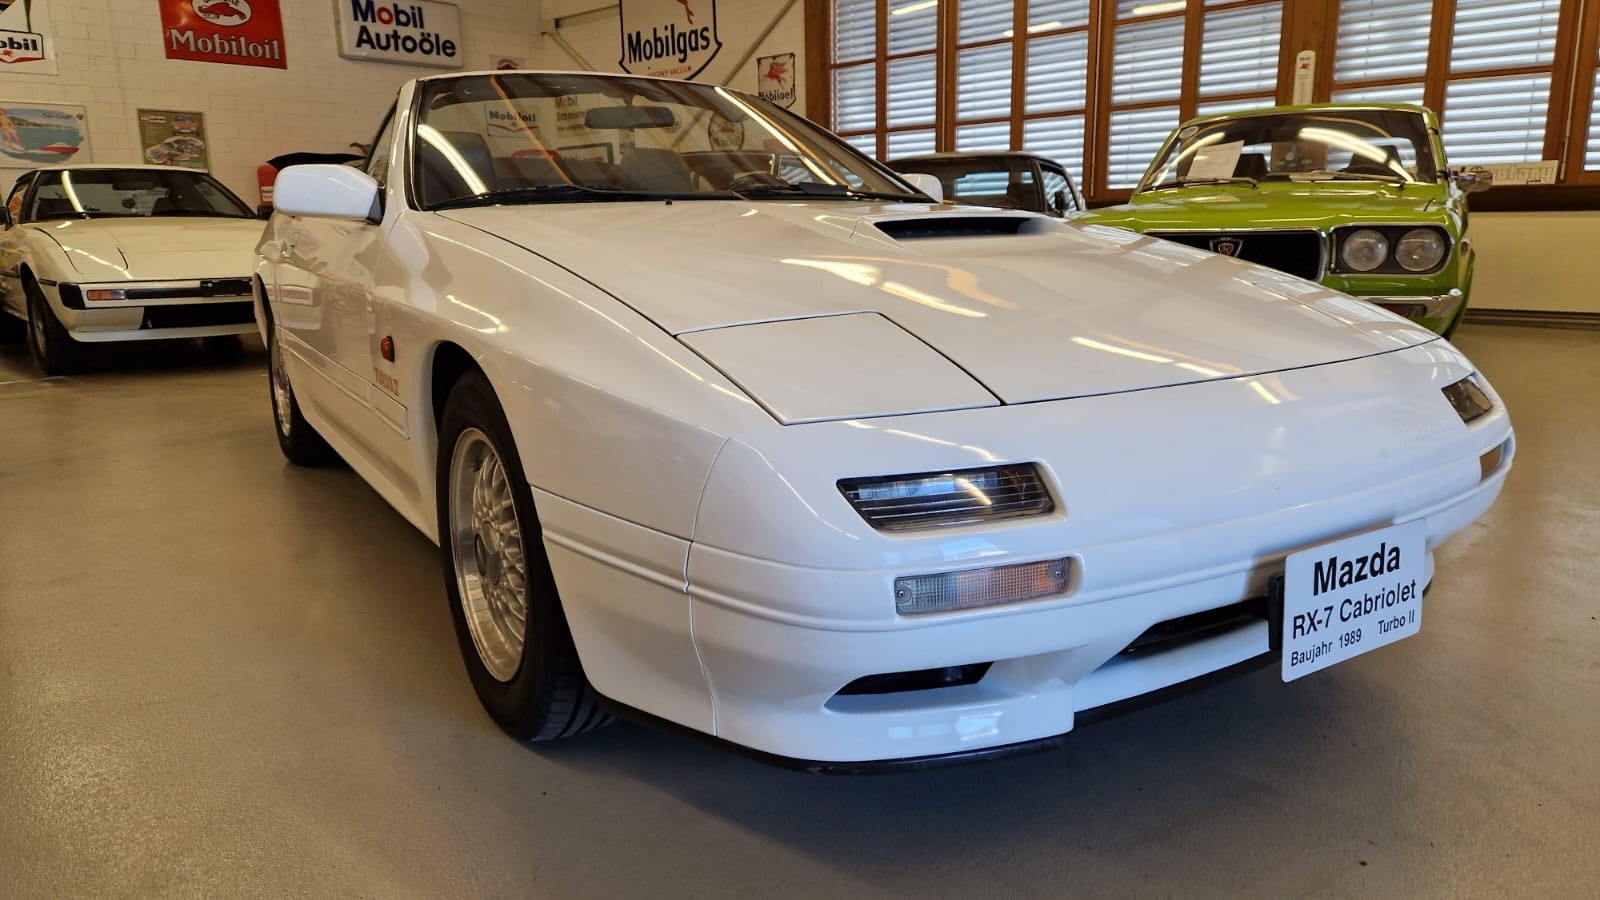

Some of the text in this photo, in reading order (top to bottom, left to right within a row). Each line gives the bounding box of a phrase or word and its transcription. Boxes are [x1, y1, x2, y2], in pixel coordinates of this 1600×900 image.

[352, 0, 424, 29] Mobil
[0, 37, 38, 51] obil
[170, 28, 280, 60] Mobiloil
[356, 25, 456, 57] Autoöle
[627, 23, 710, 64] Mobilgas
[488, 110, 536, 122] Mobloil
[1313, 542, 1400, 596] Mazda
[1292, 579, 1417, 639] RX-7 Cabriolet
[1291, 609, 1415, 667] Baujahr 1989 Turbo II
